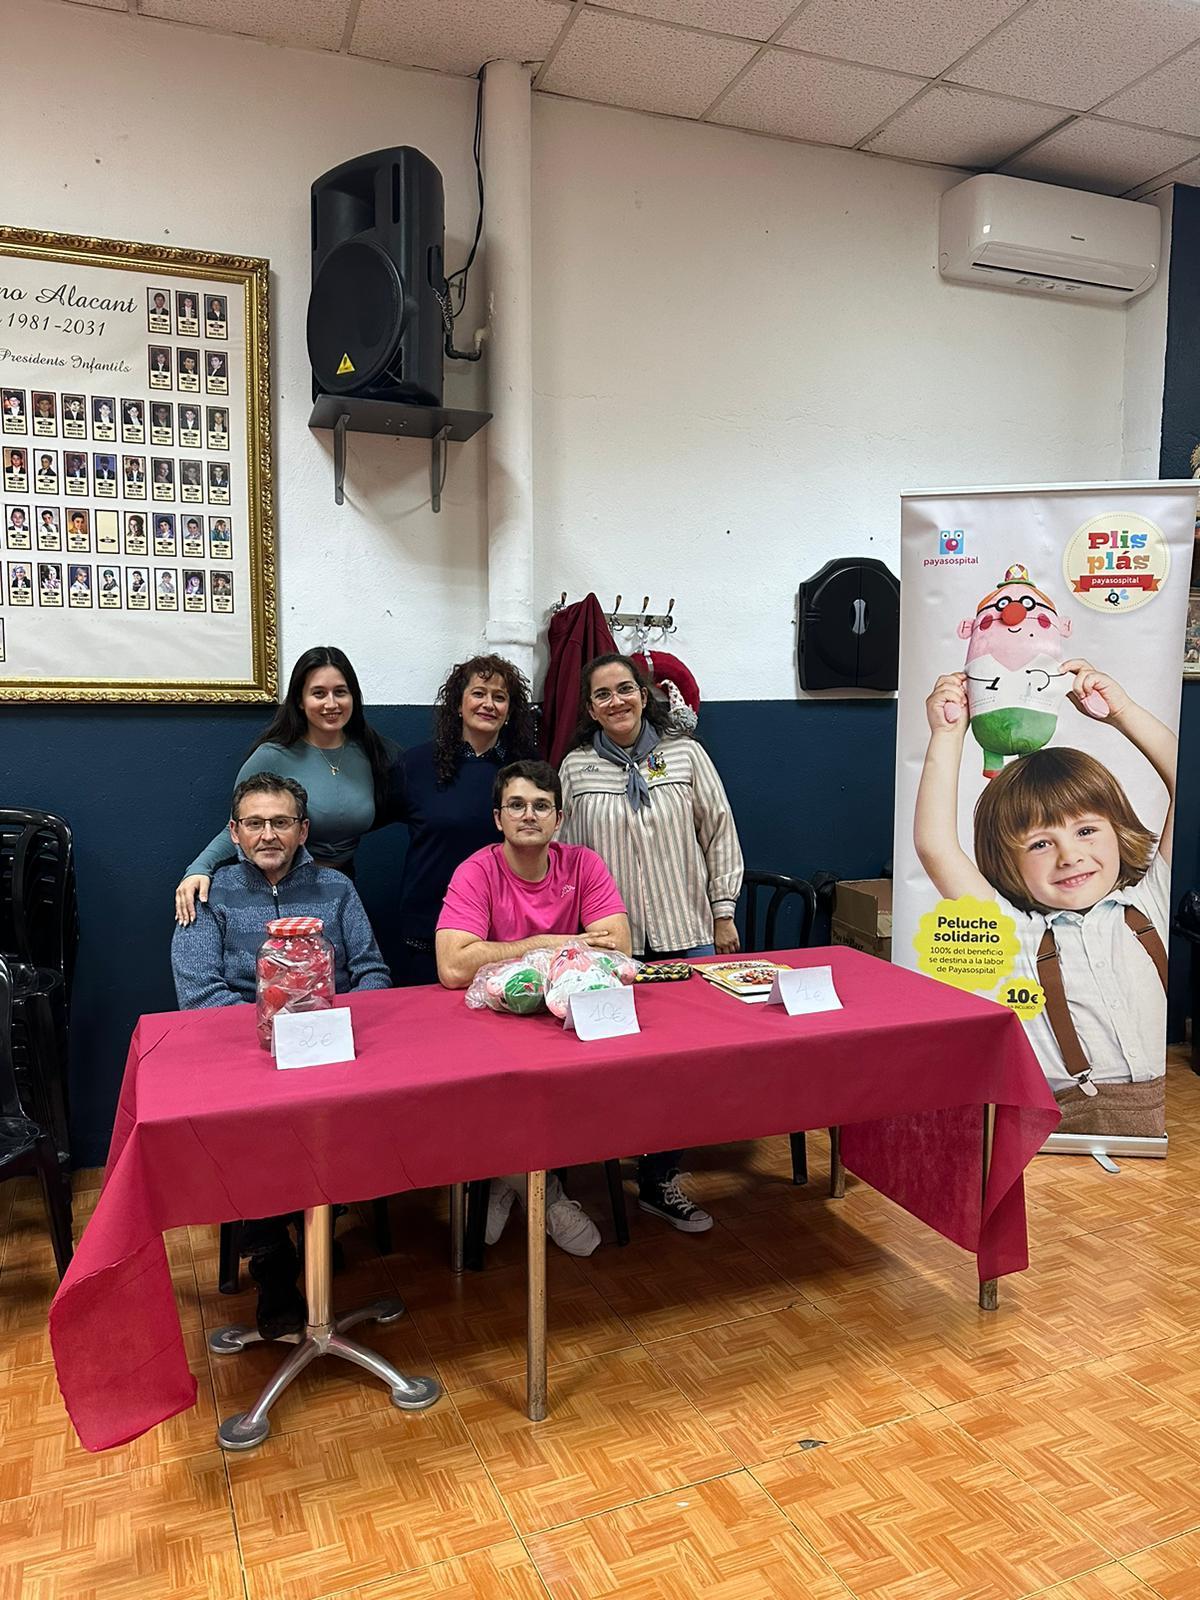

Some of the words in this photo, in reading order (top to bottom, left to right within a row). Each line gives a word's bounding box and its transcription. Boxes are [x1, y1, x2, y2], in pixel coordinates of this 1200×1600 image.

[35, 284, 138, 314] Alacant
[8, 312, 106, 337] 1981-2031
[0, 347, 67, 367] Presidents
[71, 354, 132, 374] Infantils
[1087, 530, 1148, 549] Plis
[923, 555, 979, 567] payasospital
[1087, 550, 1151, 574] plás
[1091, 576, 1140, 586] payasospital
[937, 916, 998, 930] Peluche
[934, 930, 1000, 943] solidario
[930, 946, 952, 955] 100%
[953, 947, 966, 955] del
[967, 947, 1004, 956] beneficio
[939, 956, 968, 965] destina
[974, 957, 983, 965] la
[984, 957, 1004, 966] labor
[936, 965, 947, 973] de
[948, 965, 996, 975] Payasospital
[1006, 988, 1039, 1004] 10€
